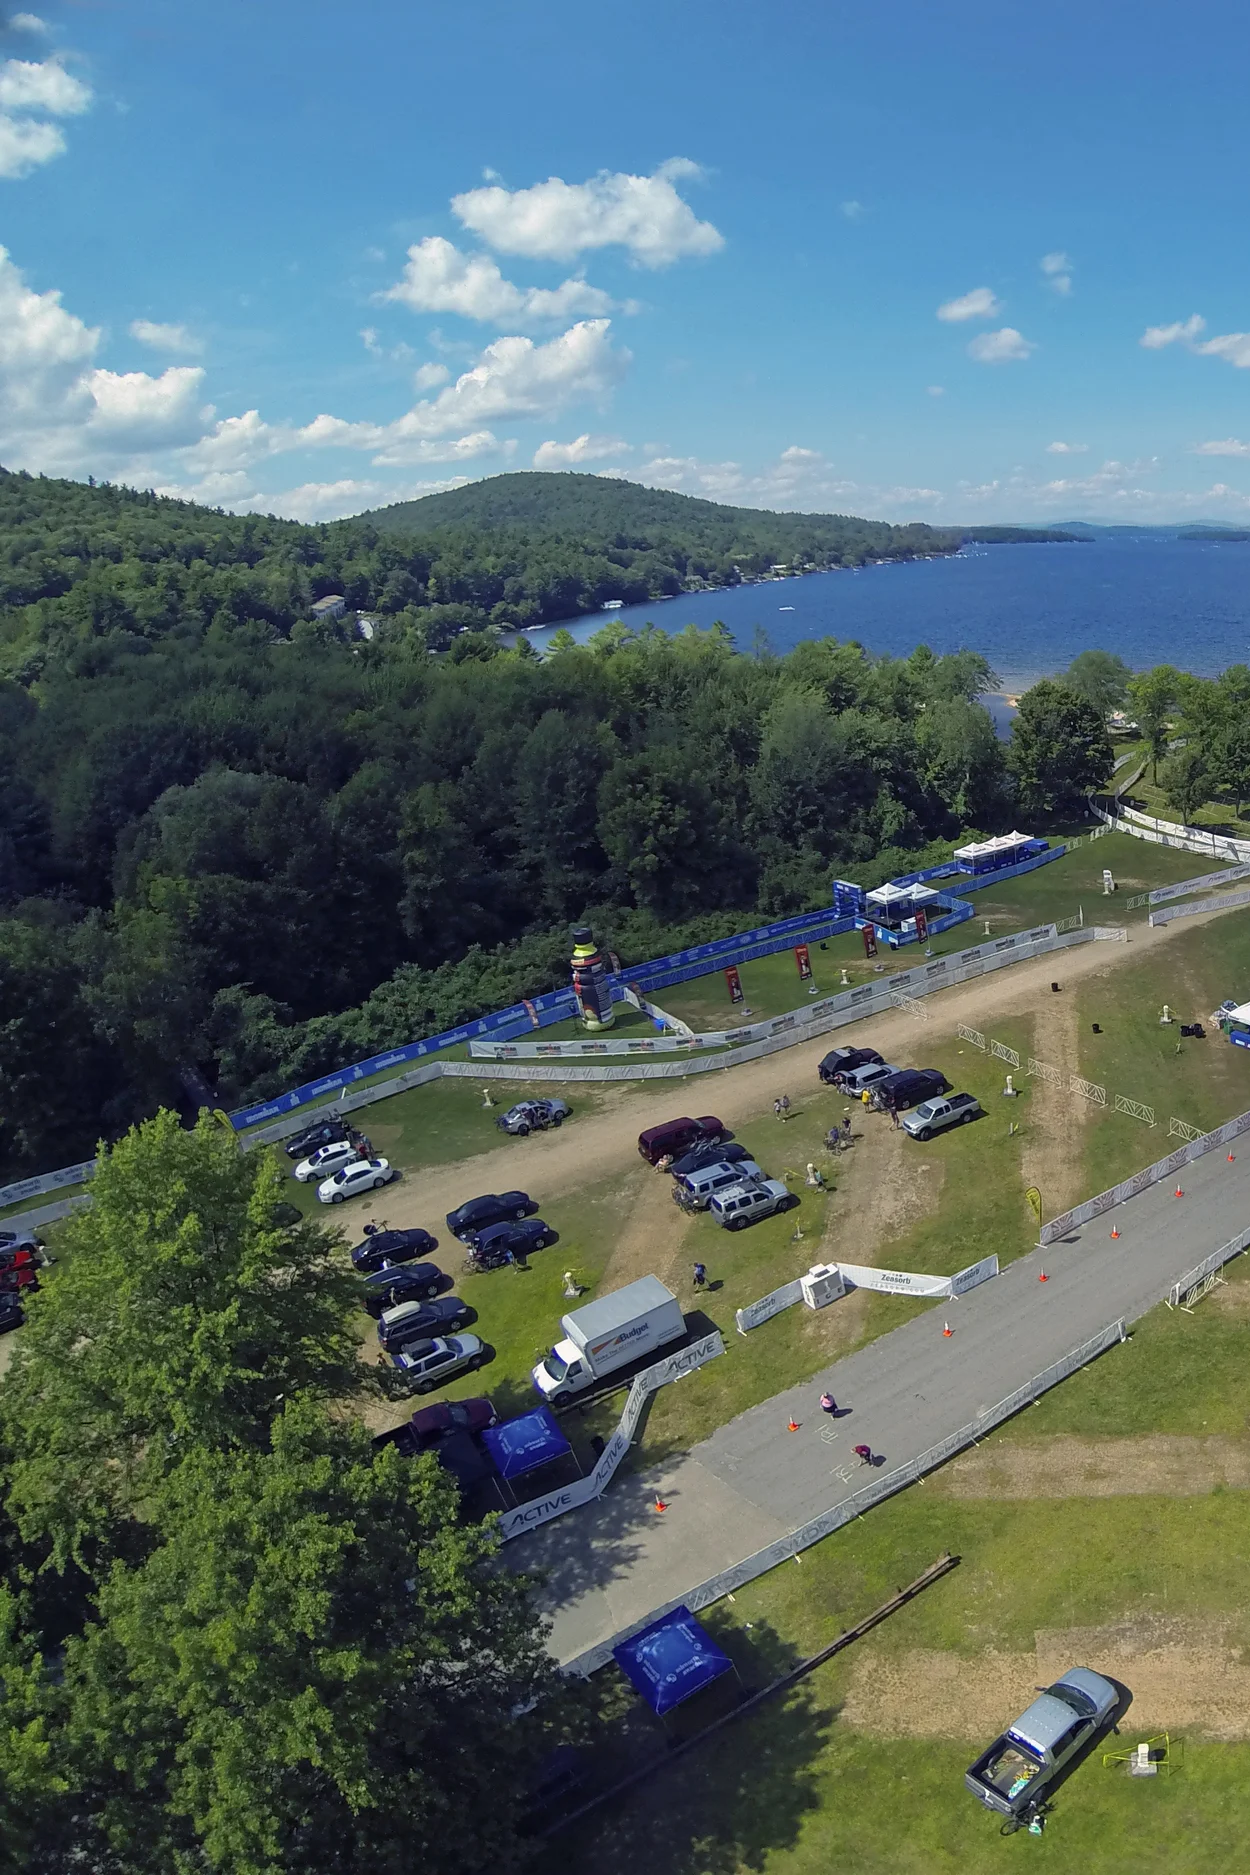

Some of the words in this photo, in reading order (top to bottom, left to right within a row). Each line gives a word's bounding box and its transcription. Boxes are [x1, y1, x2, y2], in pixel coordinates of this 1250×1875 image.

[881, 1274, 911, 1284] Zeasorb
[620, 1322, 650, 1342] Budget
[664, 1341, 716, 1379] ACTIVE
[627, 1377, 649, 1424] ACTIVE
[592, 1435, 624, 1493] ACTIVE
[507, 1493, 572, 1532] ACTIVE
